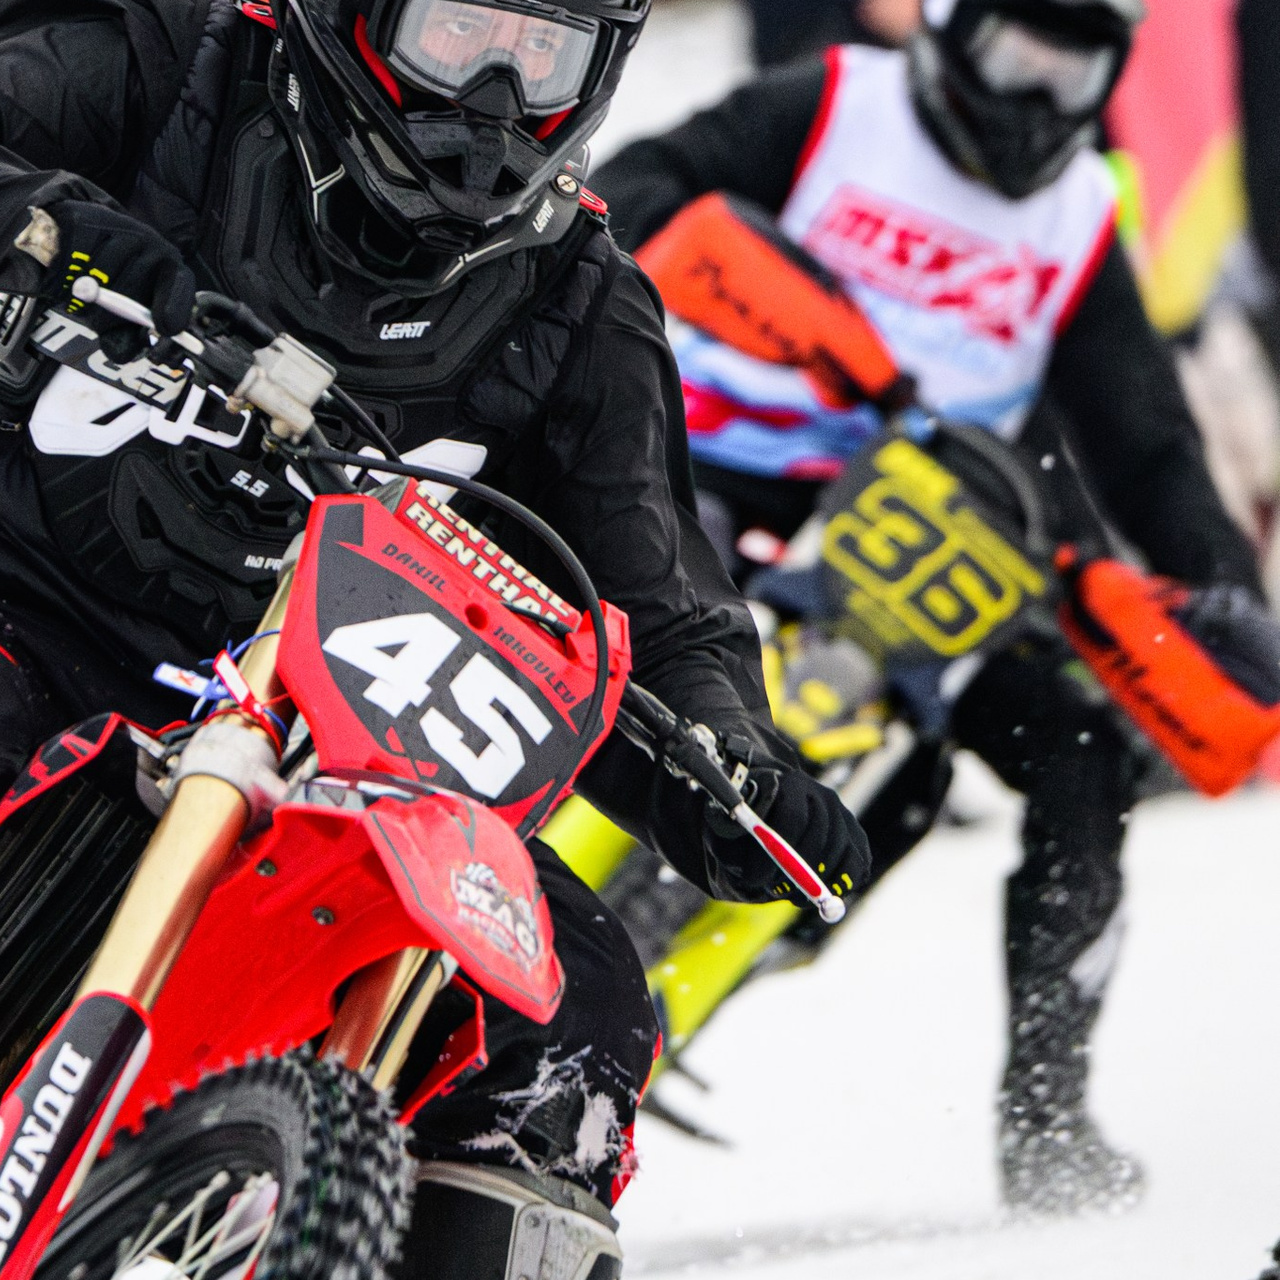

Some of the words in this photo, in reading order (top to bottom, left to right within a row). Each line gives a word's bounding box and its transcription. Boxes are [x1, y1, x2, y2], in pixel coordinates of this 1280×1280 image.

[532, 199, 555, 234] LEATT
[379, 321, 431, 340] LEATT
[230, 469, 270, 498] 5.5
[822, 475, 1023, 658] 36
[322, 613, 553, 800] 45
